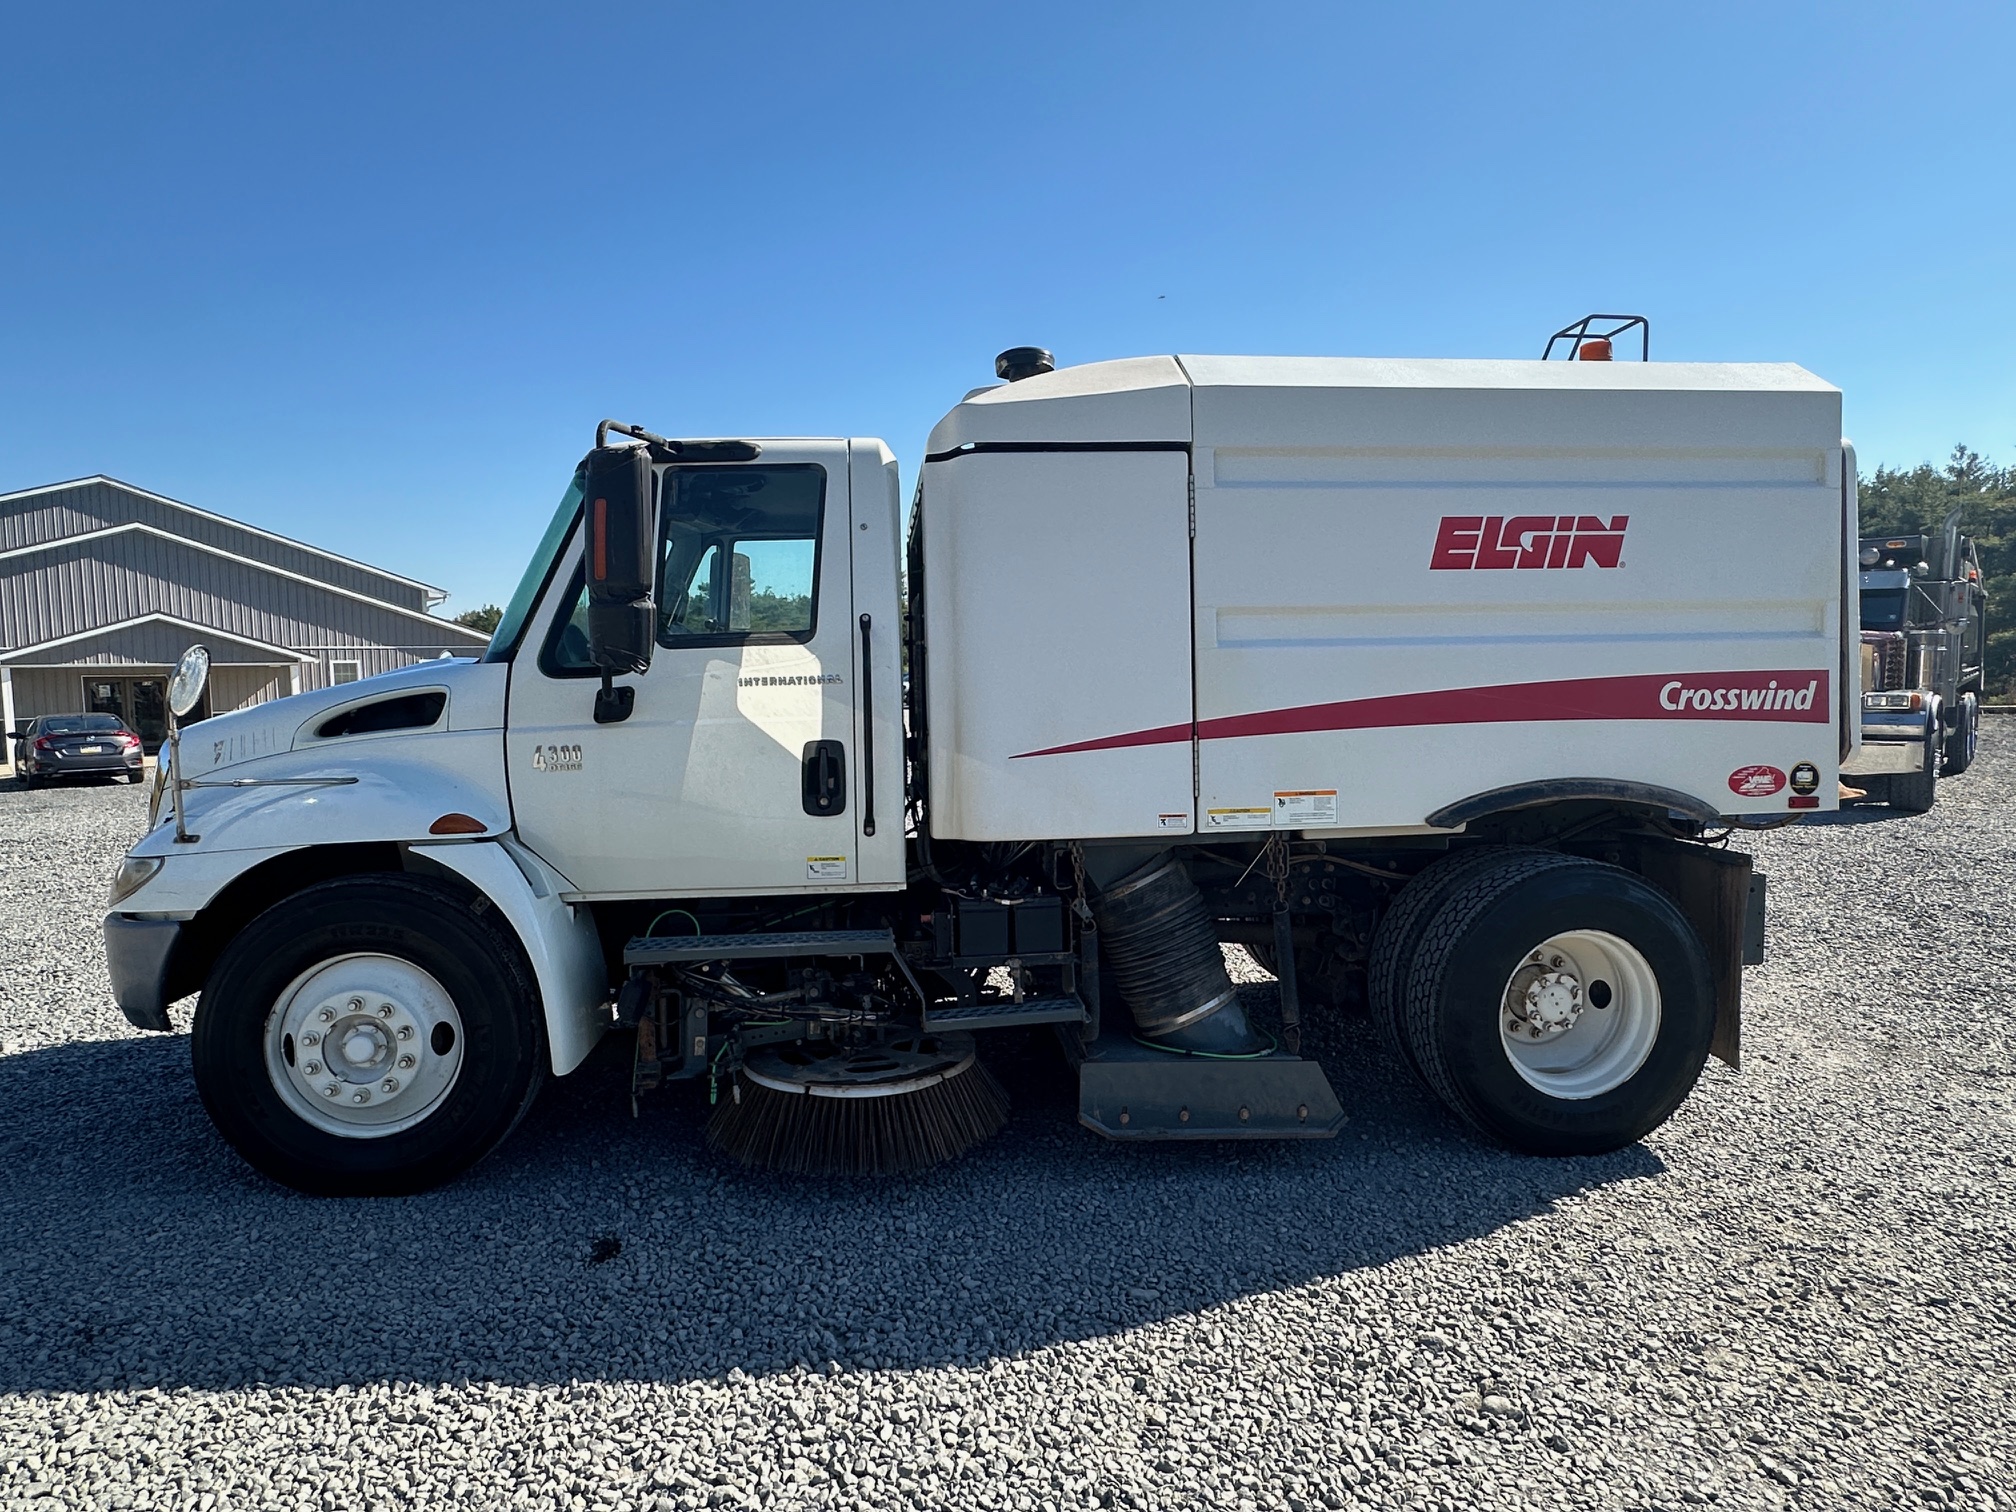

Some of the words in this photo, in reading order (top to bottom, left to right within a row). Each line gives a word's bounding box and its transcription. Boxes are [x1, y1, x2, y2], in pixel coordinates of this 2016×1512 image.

[1430, 515, 1630, 570] ELGIN
[738, 674, 843, 687] INTERNATIONAL
[1659, 680, 1818, 711] Crosswind
[532, 745, 582, 772] 4300
